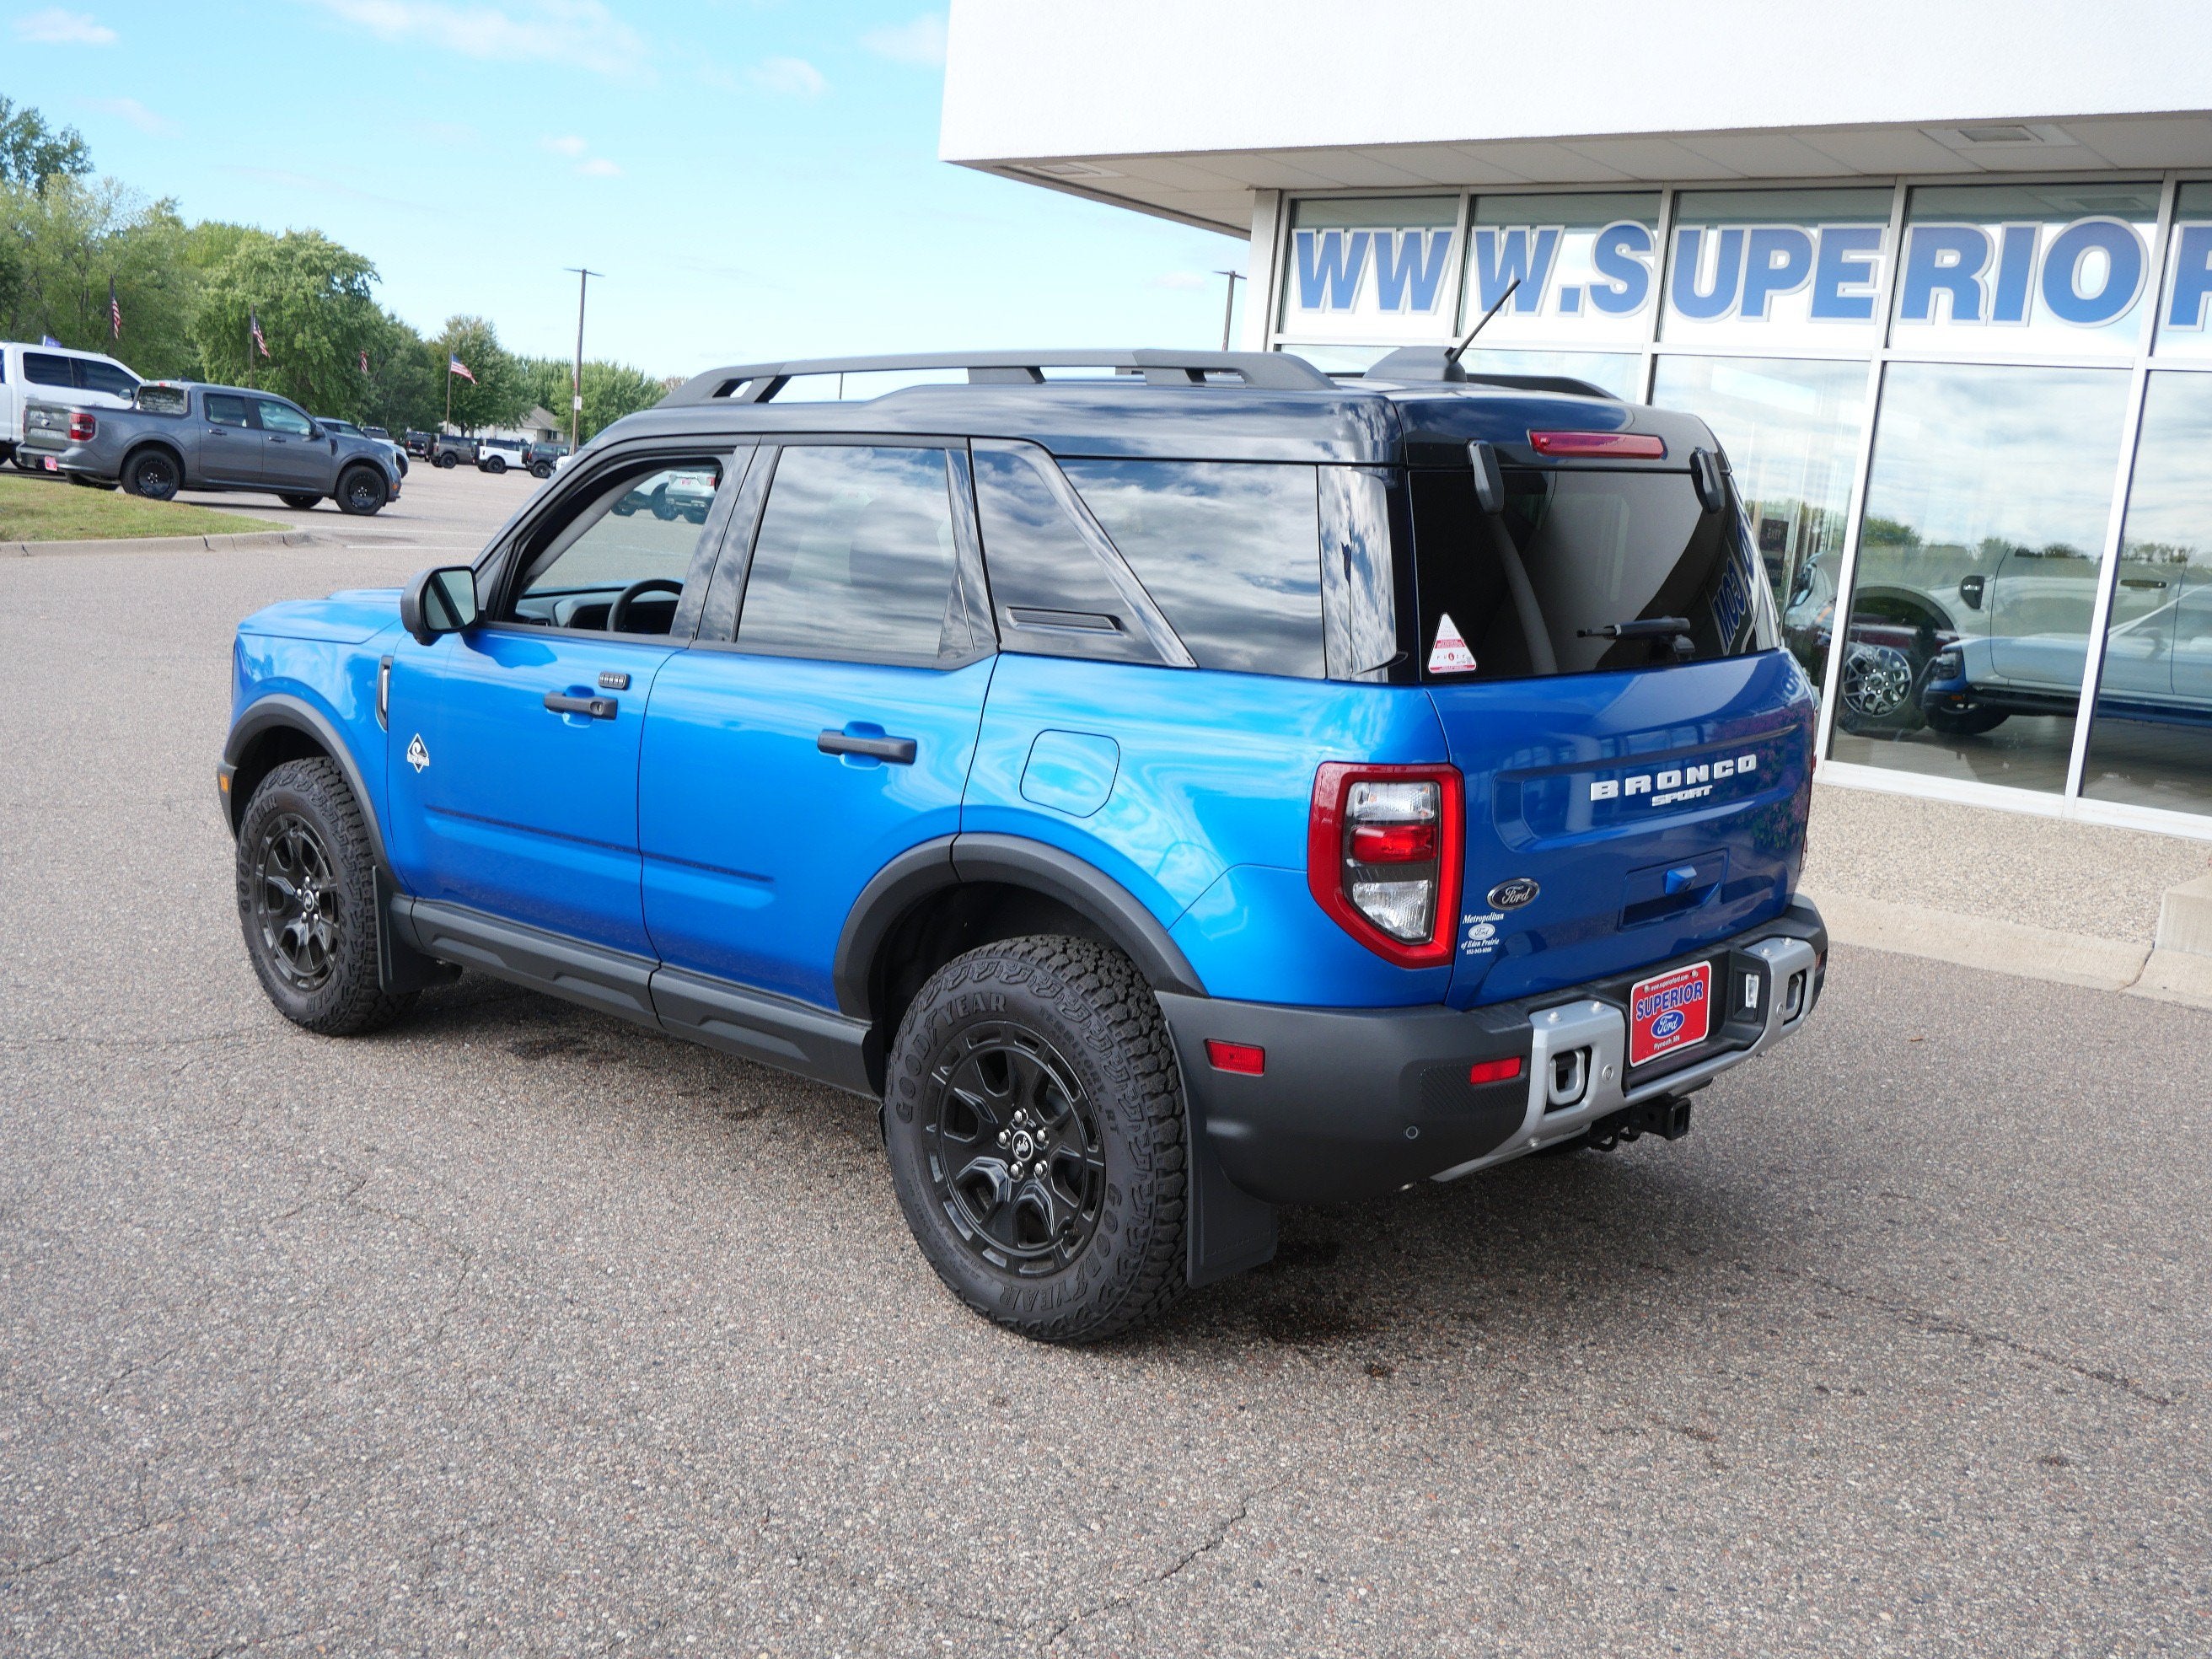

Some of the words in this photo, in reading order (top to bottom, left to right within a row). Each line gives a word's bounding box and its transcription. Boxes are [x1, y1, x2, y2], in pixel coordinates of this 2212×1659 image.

[1590, 754, 1757, 802] BRONCO
[1651, 785, 1713, 807] SPORT
[1502, 885, 1530, 905] Ford
[1462, 911, 1505, 925] Metropolitan
[1635, 980, 1704, 1022] SUPERIOR
[1656, 1013, 1679, 1035] Ford
[895, 991, 1007, 1124] GOODYEAR
